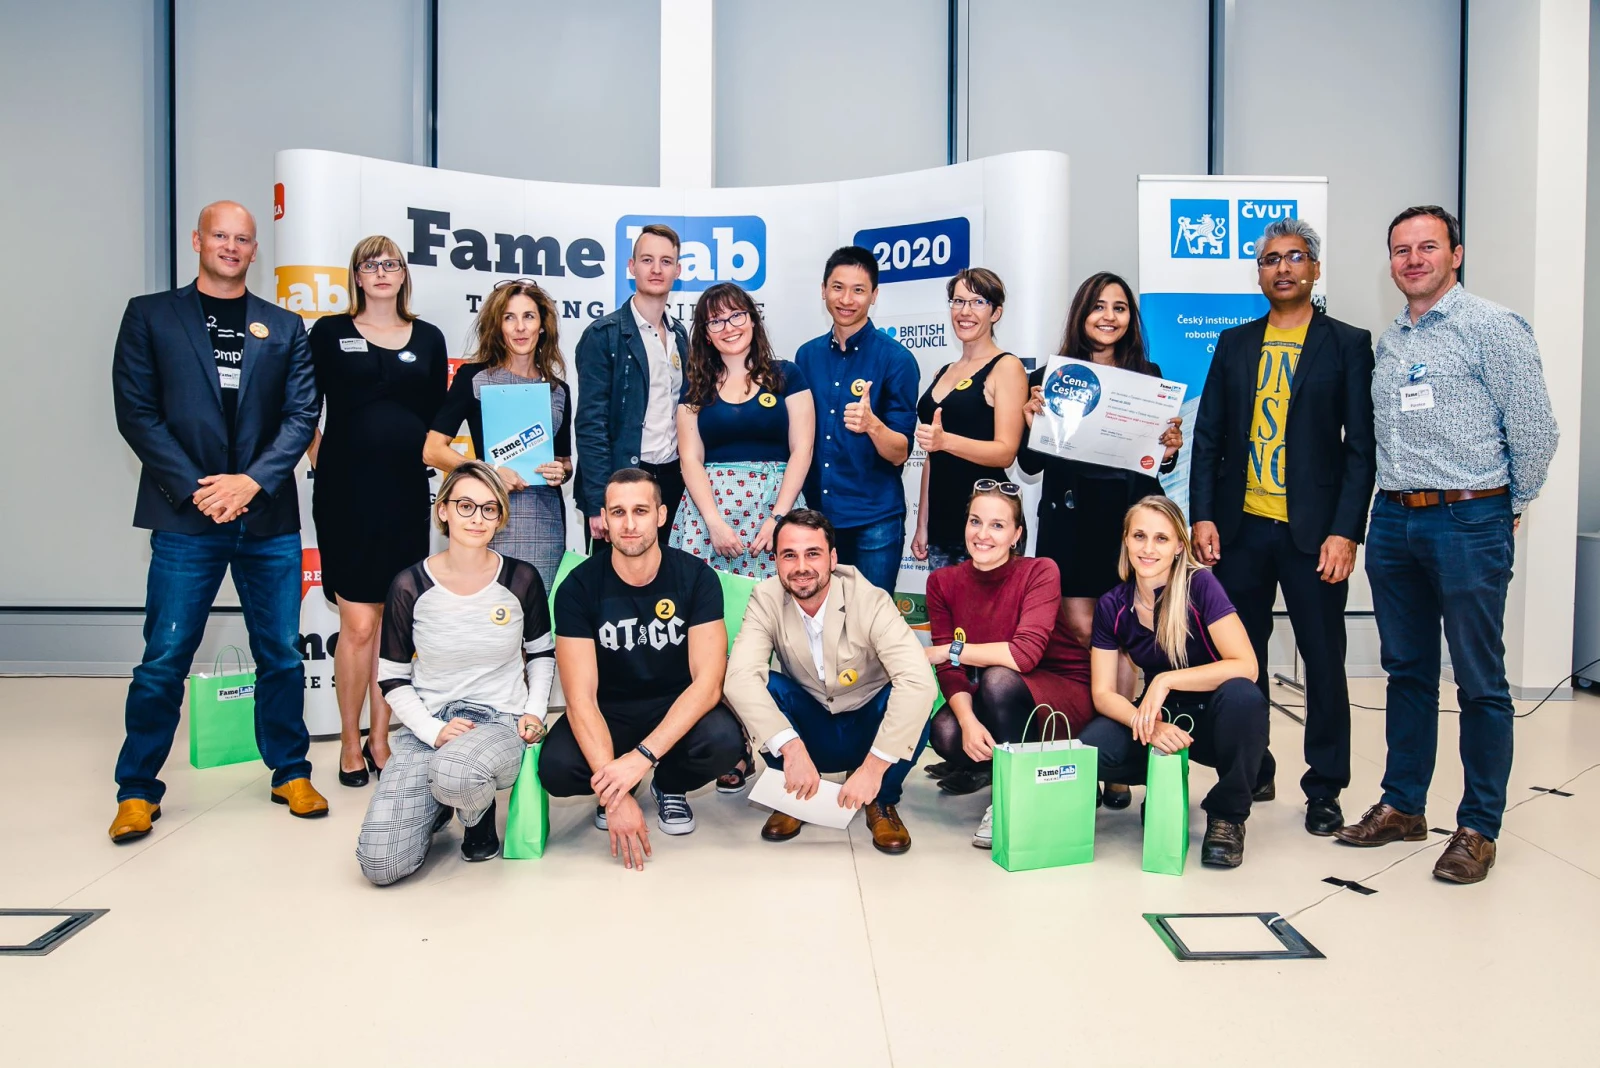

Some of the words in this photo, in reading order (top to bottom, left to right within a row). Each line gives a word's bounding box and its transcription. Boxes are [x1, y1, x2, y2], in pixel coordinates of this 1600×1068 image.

[1241, 201, 1294, 219] ČVUT
[407, 207, 605, 279] Fame
[872, 234, 951, 272] 2020
[1177, 314, 1203, 326] Český
[1205, 316, 1238, 325] institut
[899, 323, 946, 338] BRITISH
[855, 381, 863, 392] 6
[1062, 374, 1088, 388] Cena
[763, 396, 771, 404] 4
[491, 439, 521, 459] Fame
[520, 426, 544, 442] Lab
[495, 608, 506, 621] 9
[660, 602, 670, 616] 2
[218, 689, 239, 697] Fame
[1037, 769, 1059, 777] Fame
